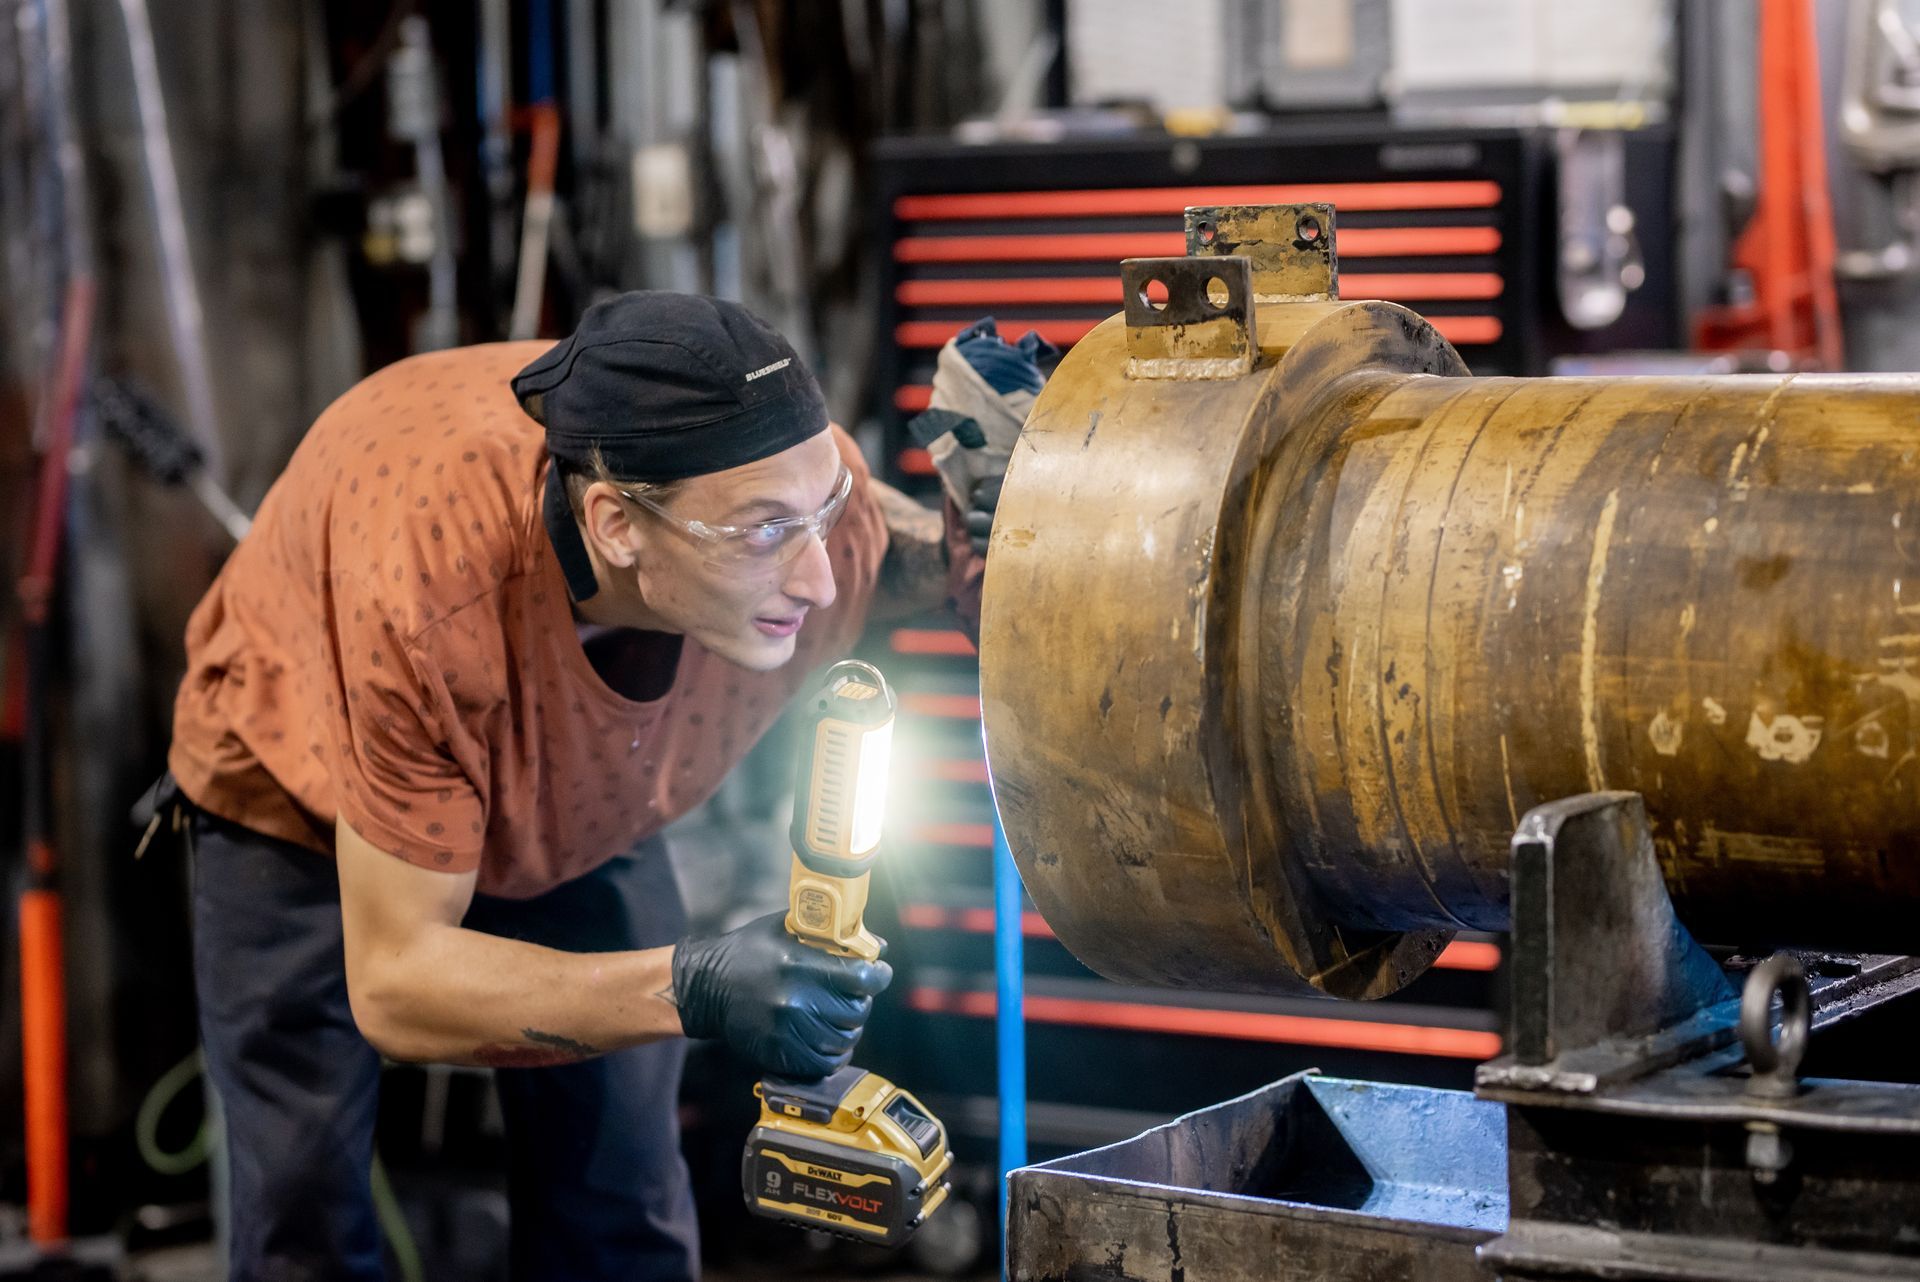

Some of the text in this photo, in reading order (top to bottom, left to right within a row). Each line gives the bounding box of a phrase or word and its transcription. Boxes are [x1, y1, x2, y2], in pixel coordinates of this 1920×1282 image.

[765, 1171, 782, 1188] 9
[807, 1166, 843, 1182] DeWALT
[792, 1181, 883, 1213] FLEXVOLT
